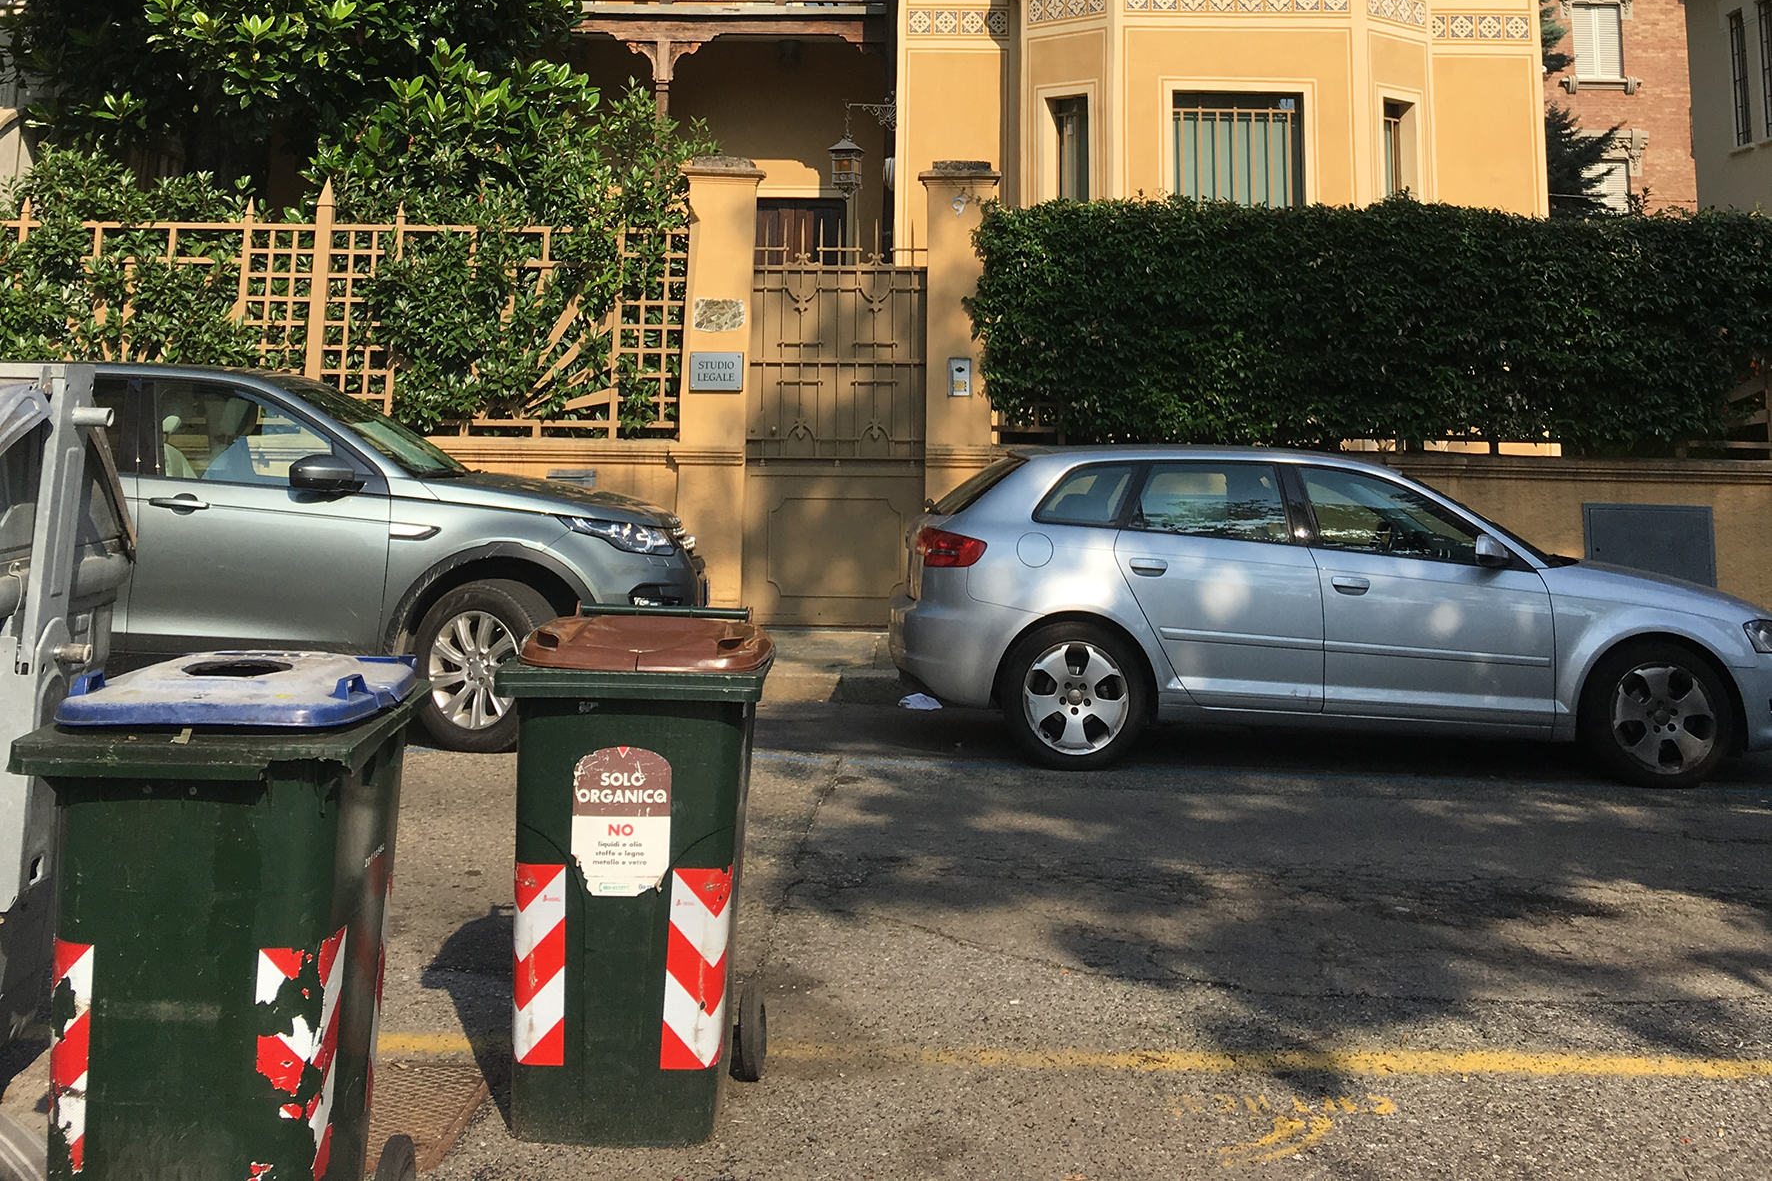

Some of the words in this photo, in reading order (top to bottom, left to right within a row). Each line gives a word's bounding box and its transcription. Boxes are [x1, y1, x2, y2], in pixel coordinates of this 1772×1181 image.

[951, 196, 966, 218] 9
[698, 360, 735, 370] STUDIO
[697, 372, 735, 382] LEGALE
[600, 772, 644, 787] SOLO
[578, 789, 667, 804] ORGANICO
[607, 824, 634, 837] NO
[597, 840, 620, 848] liquidi
